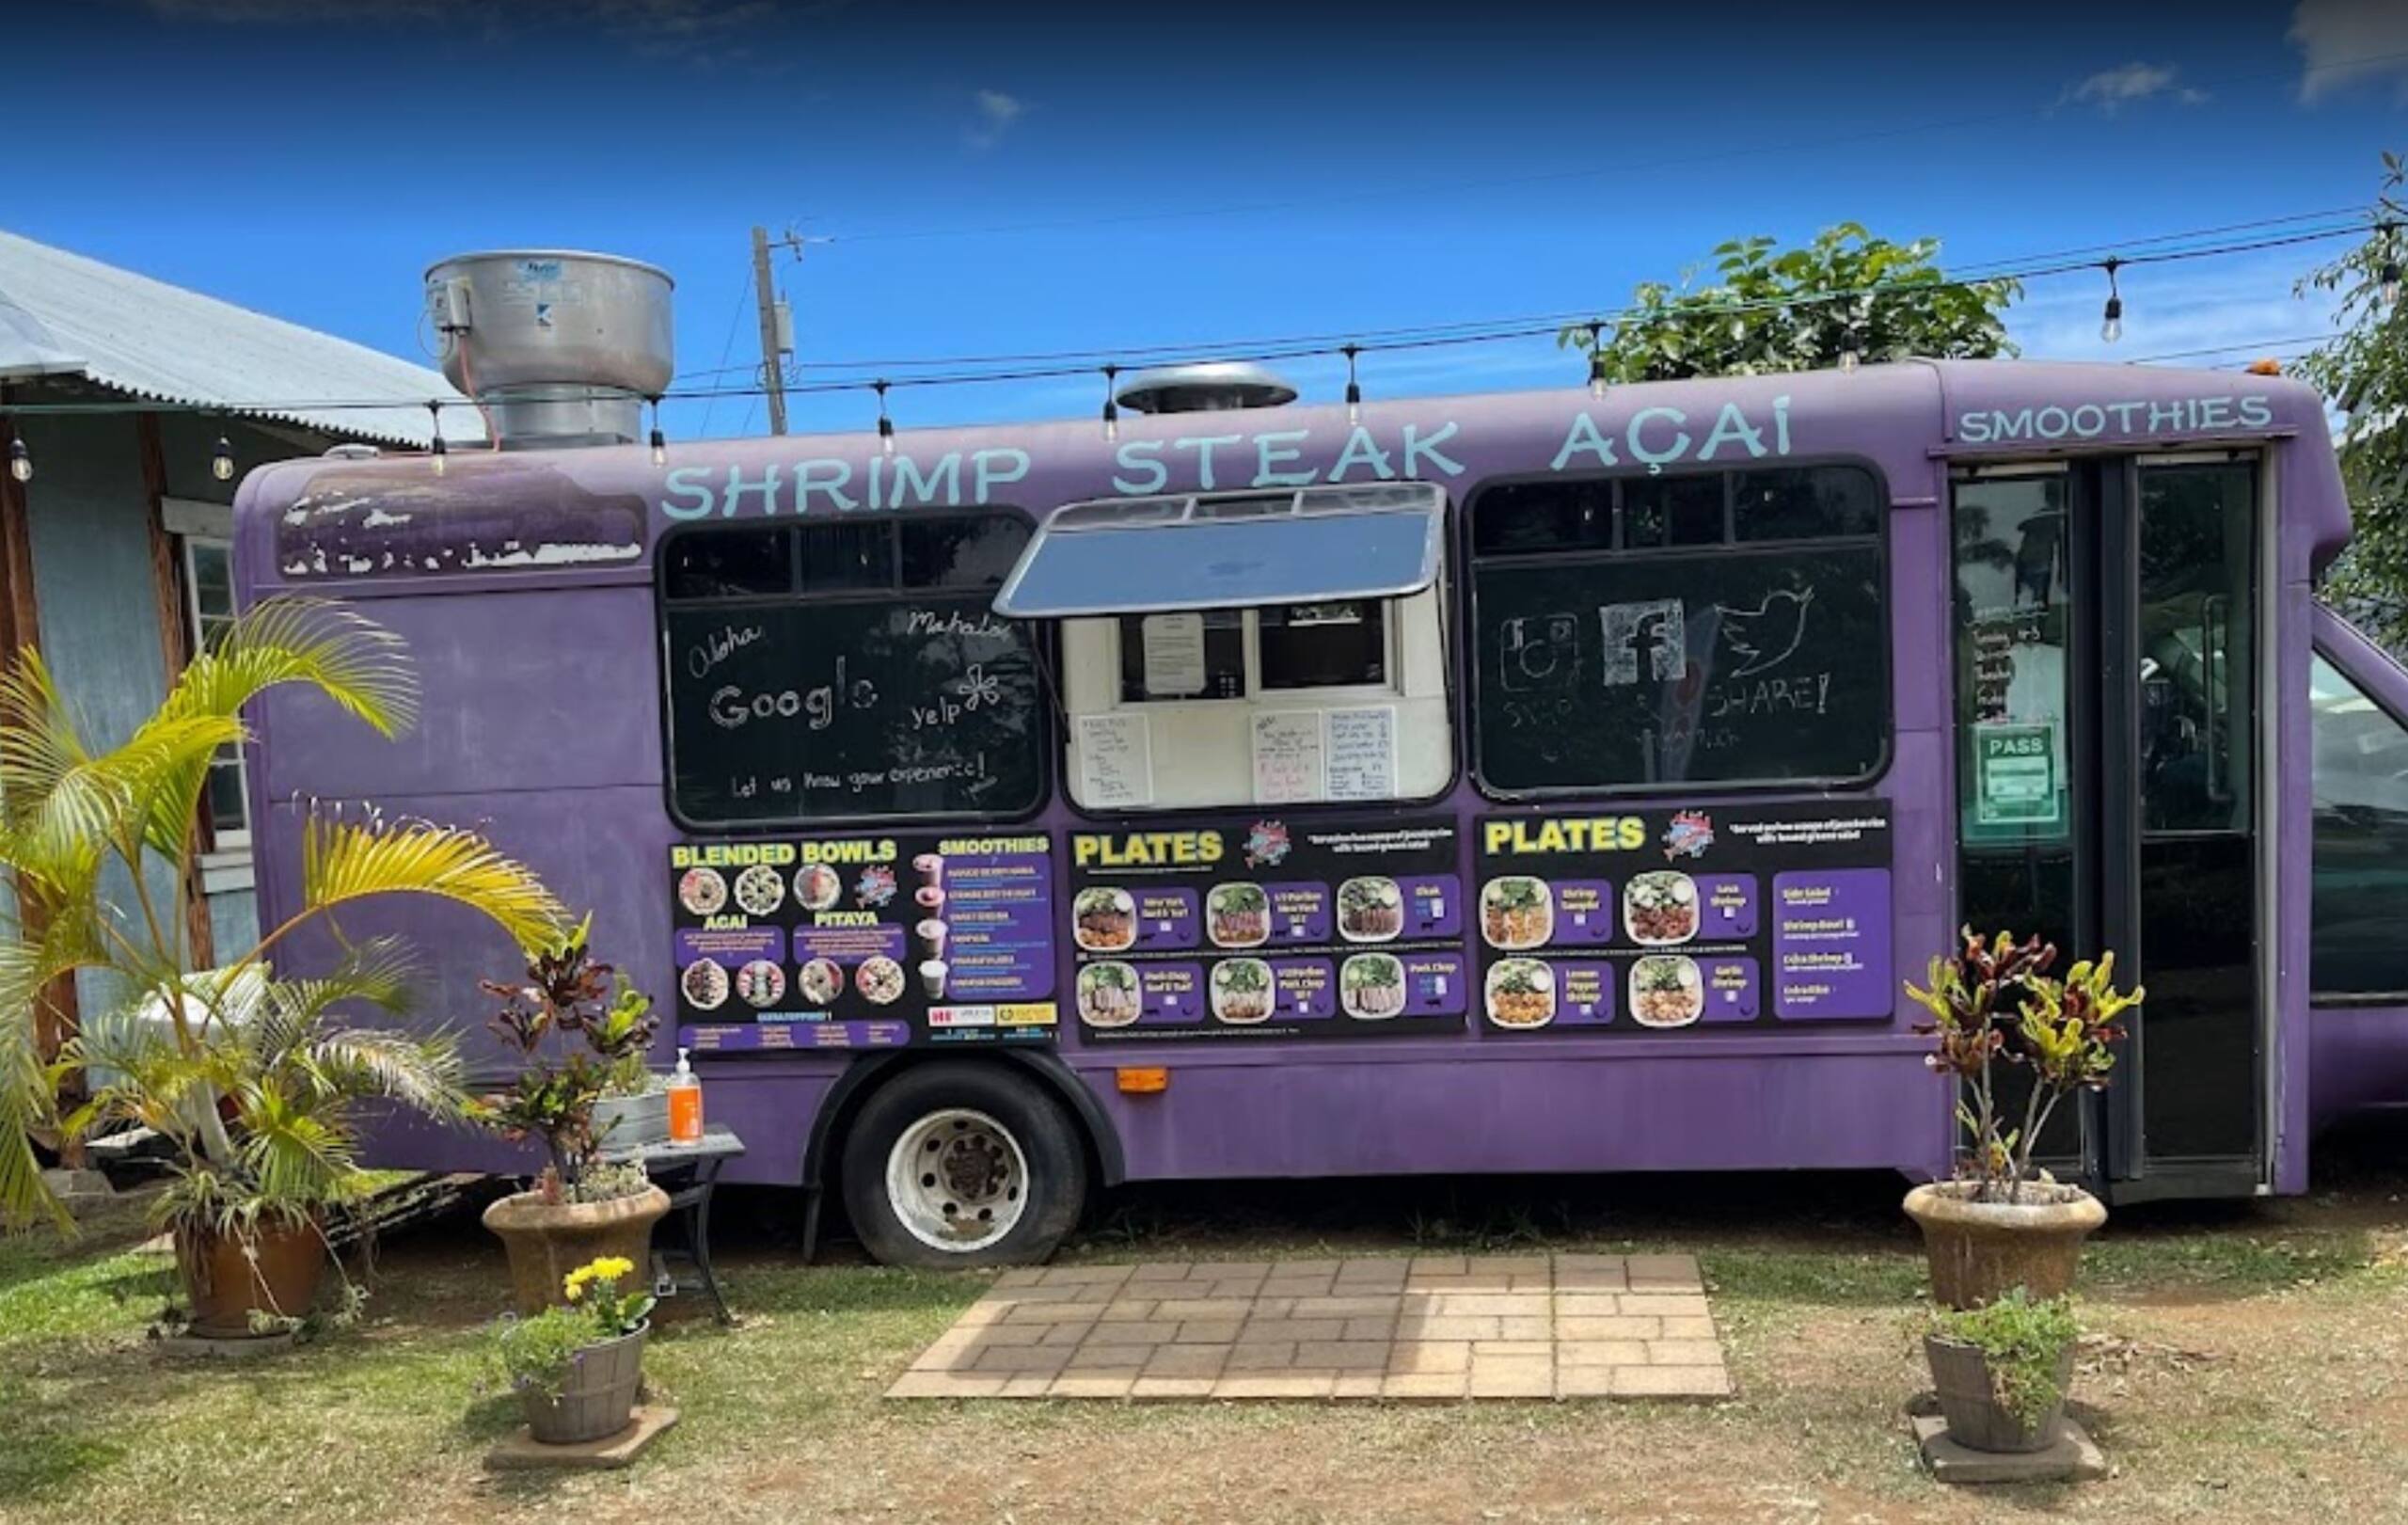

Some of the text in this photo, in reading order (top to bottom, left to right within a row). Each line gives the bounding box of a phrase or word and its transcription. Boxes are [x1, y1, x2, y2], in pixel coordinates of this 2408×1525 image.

[1959, 396, 2273, 442] SMOOTHIES
[661, 448, 1031, 520] SHRIMP
[1113, 421, 1465, 495] STEAK
[1706, 671, 1830, 719] SHARE!
[1989, 738, 2044, 755] PASS
[673, 839, 897, 866] BLENDED BOWLS
[938, 836, 1050, 855] SMOOTHIES
[1073, 832, 1224, 866] PLATES
[1482, 817, 1646, 855] PLATES
[815, 913, 879, 927] PITAYA
